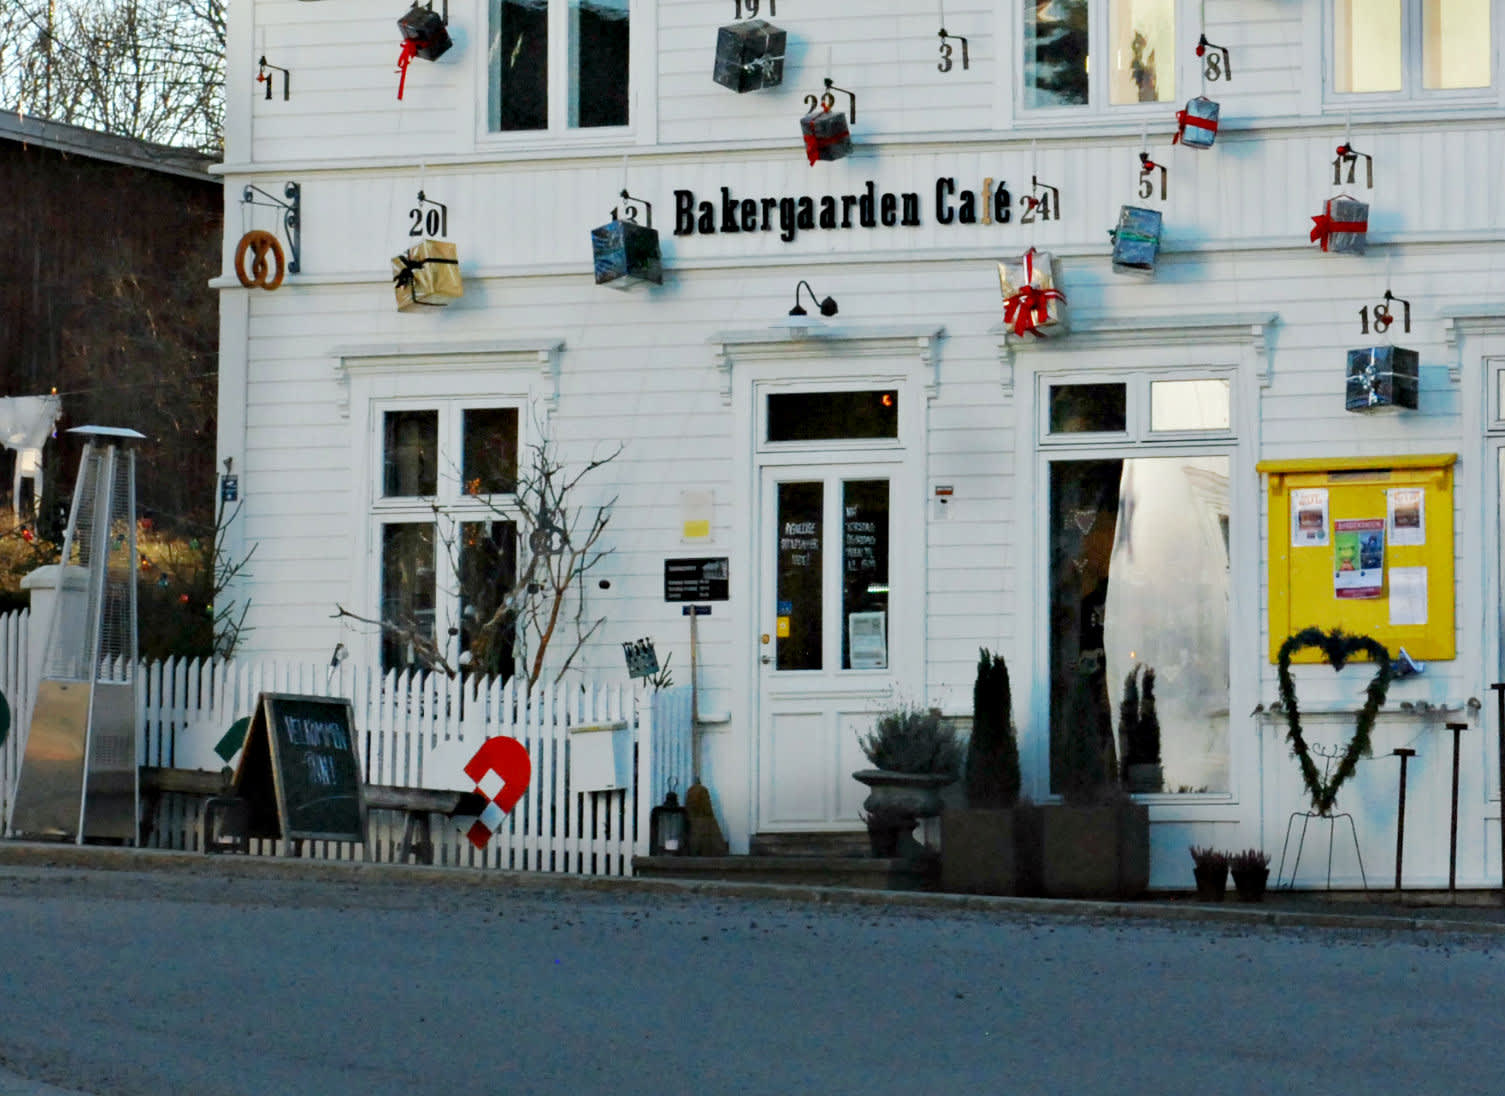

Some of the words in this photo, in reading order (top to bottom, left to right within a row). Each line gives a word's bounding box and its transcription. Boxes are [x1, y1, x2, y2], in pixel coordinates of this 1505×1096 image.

[937, 42, 953, 72] 3
[1204, 52, 1221, 82] 8
[1138, 169, 1154, 199] 5
[1331, 154, 1356, 185] 17
[408, 208, 439, 237] 20
[673, 181, 921, 242] Bakergaarden
[935, 176, 1012, 225] Café
[1020, 191, 1050, 224] 24
[1358, 304, 1387, 335] 18
